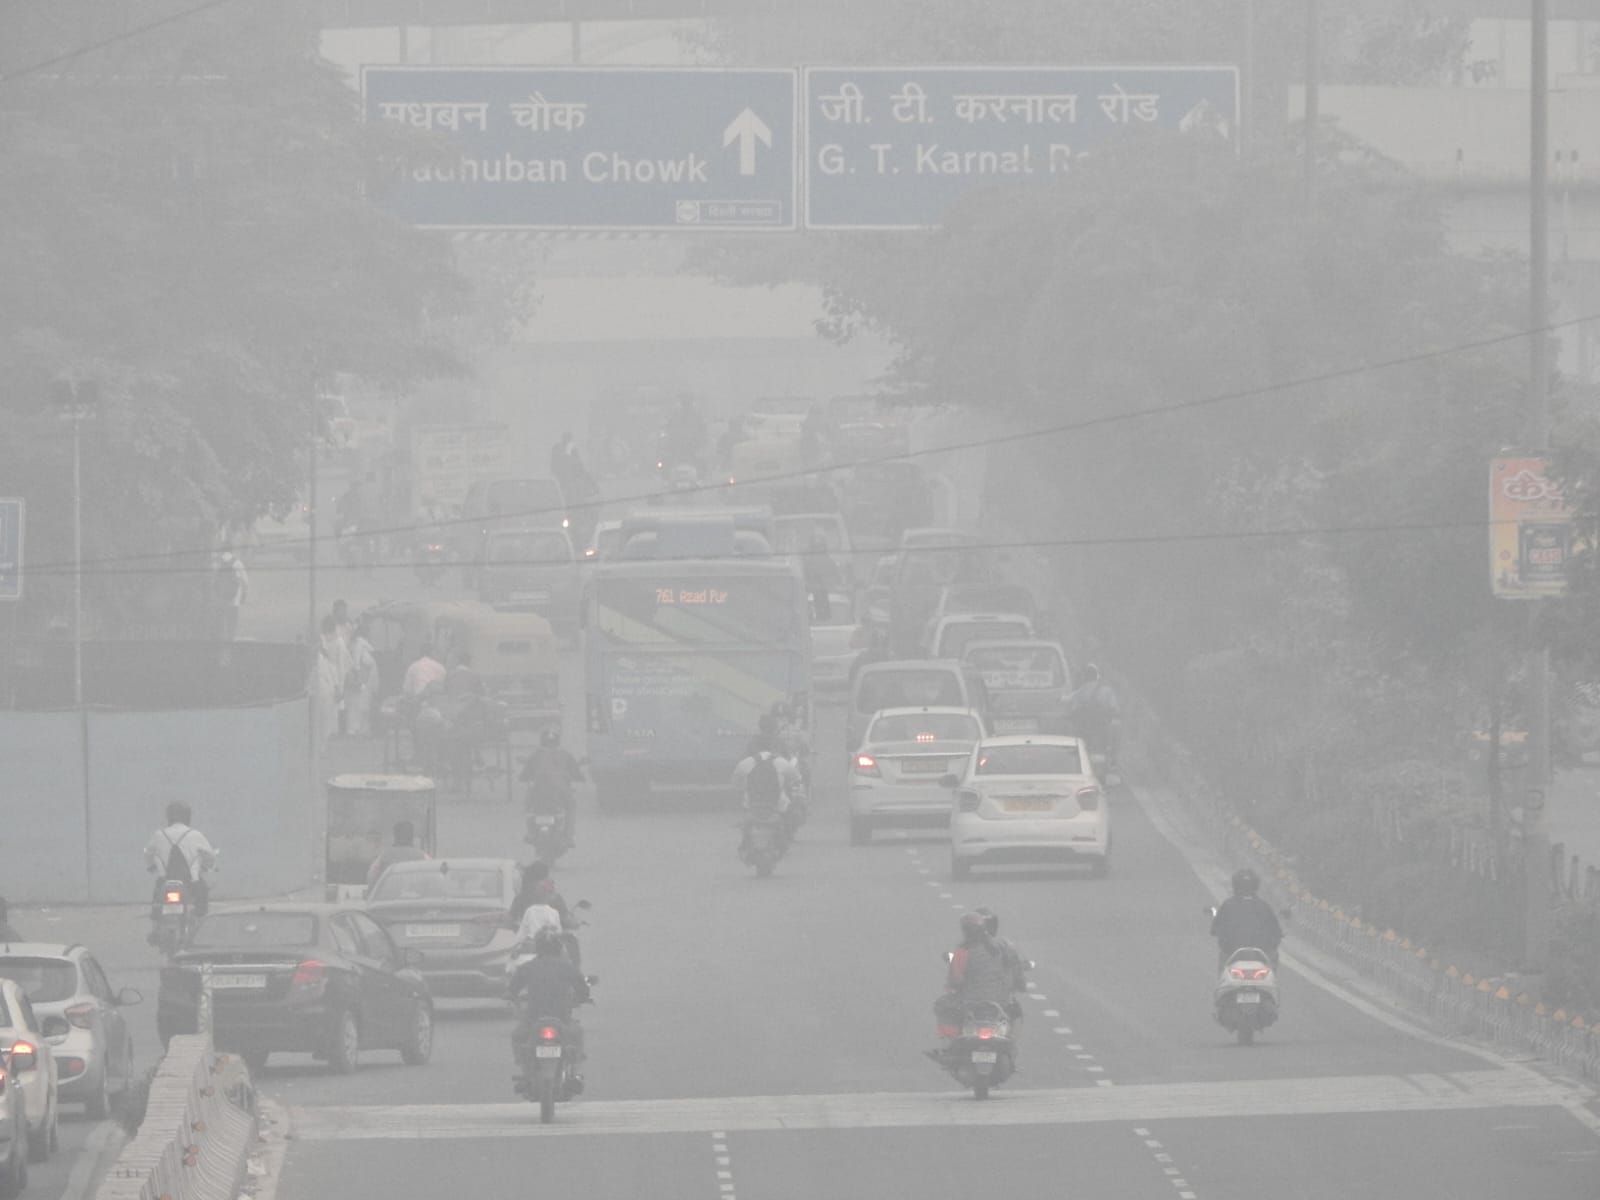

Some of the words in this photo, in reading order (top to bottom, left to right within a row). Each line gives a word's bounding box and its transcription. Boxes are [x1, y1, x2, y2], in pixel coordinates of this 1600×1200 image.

[509, 90, 588, 131] चौक
[818, 82, 872, 124] जी.
[890, 82, 934, 124] टी.
[953, 94, 1079, 124] करनाल
[1097, 82, 1161, 124] रोड
[377, 152, 566, 183] ahuban
[583, 151, 708, 183] Chowk
[818, 143, 856, 175] G.
[870, 143, 900, 175] T.
[916, 143, 1035, 175] Karnal
[656, 588, 675, 604] 761
